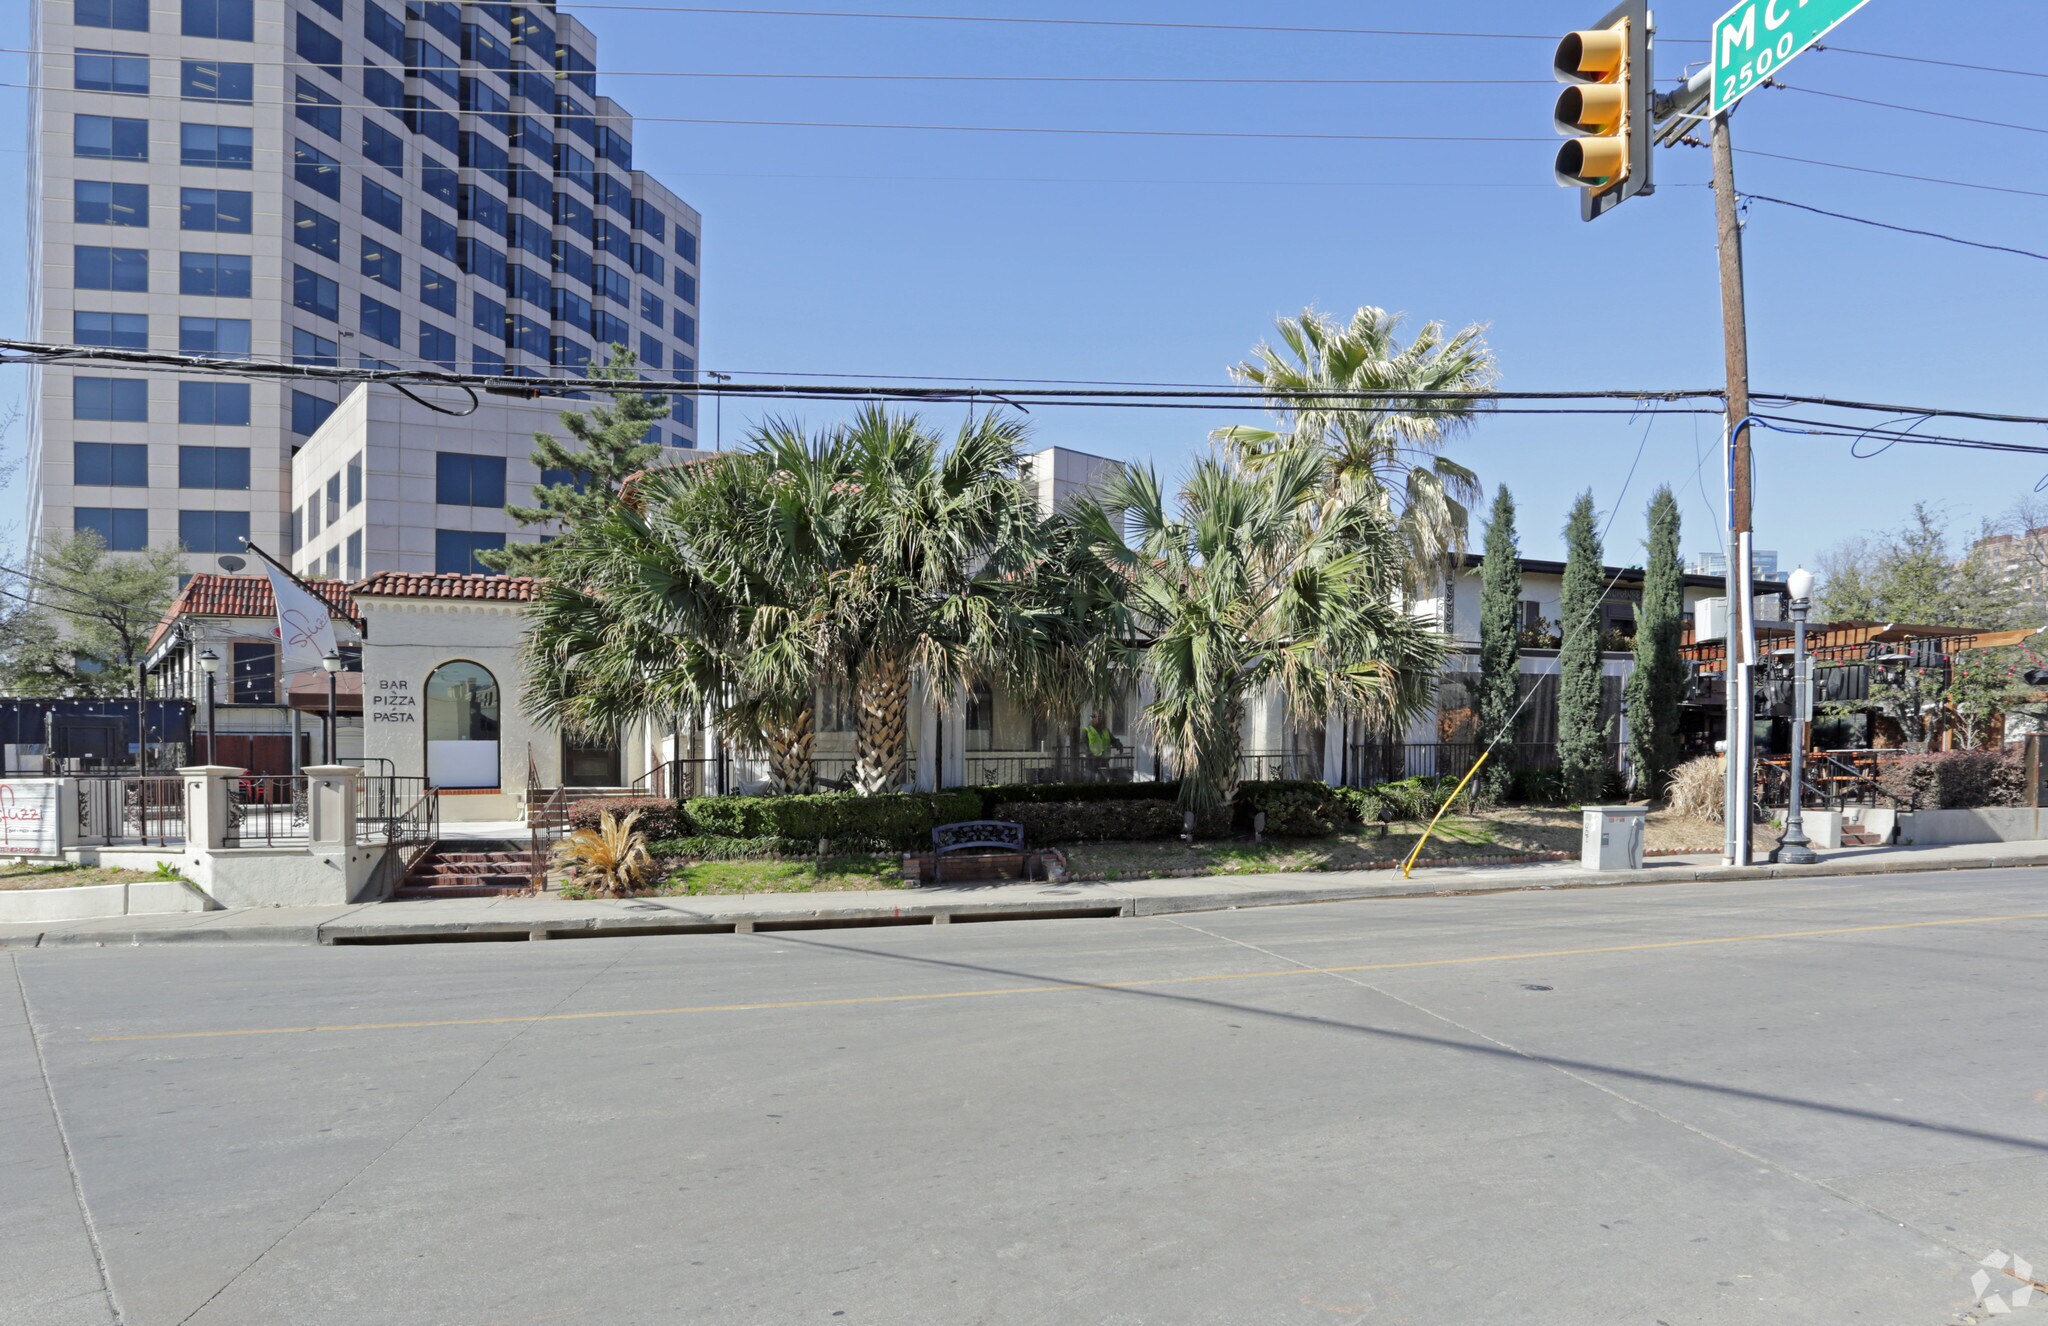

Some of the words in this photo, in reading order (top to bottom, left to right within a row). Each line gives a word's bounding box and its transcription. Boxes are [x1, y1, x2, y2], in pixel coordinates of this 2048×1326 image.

[1722, 0, 1808, 69] MC
[1723, 32, 1793, 102] 2500
[373, 695, 416, 706] PIZZA
[380, 680, 408, 690] BAR
[373, 712, 415, 723] PASTA
[0, 784, 44, 845] fuzzi
